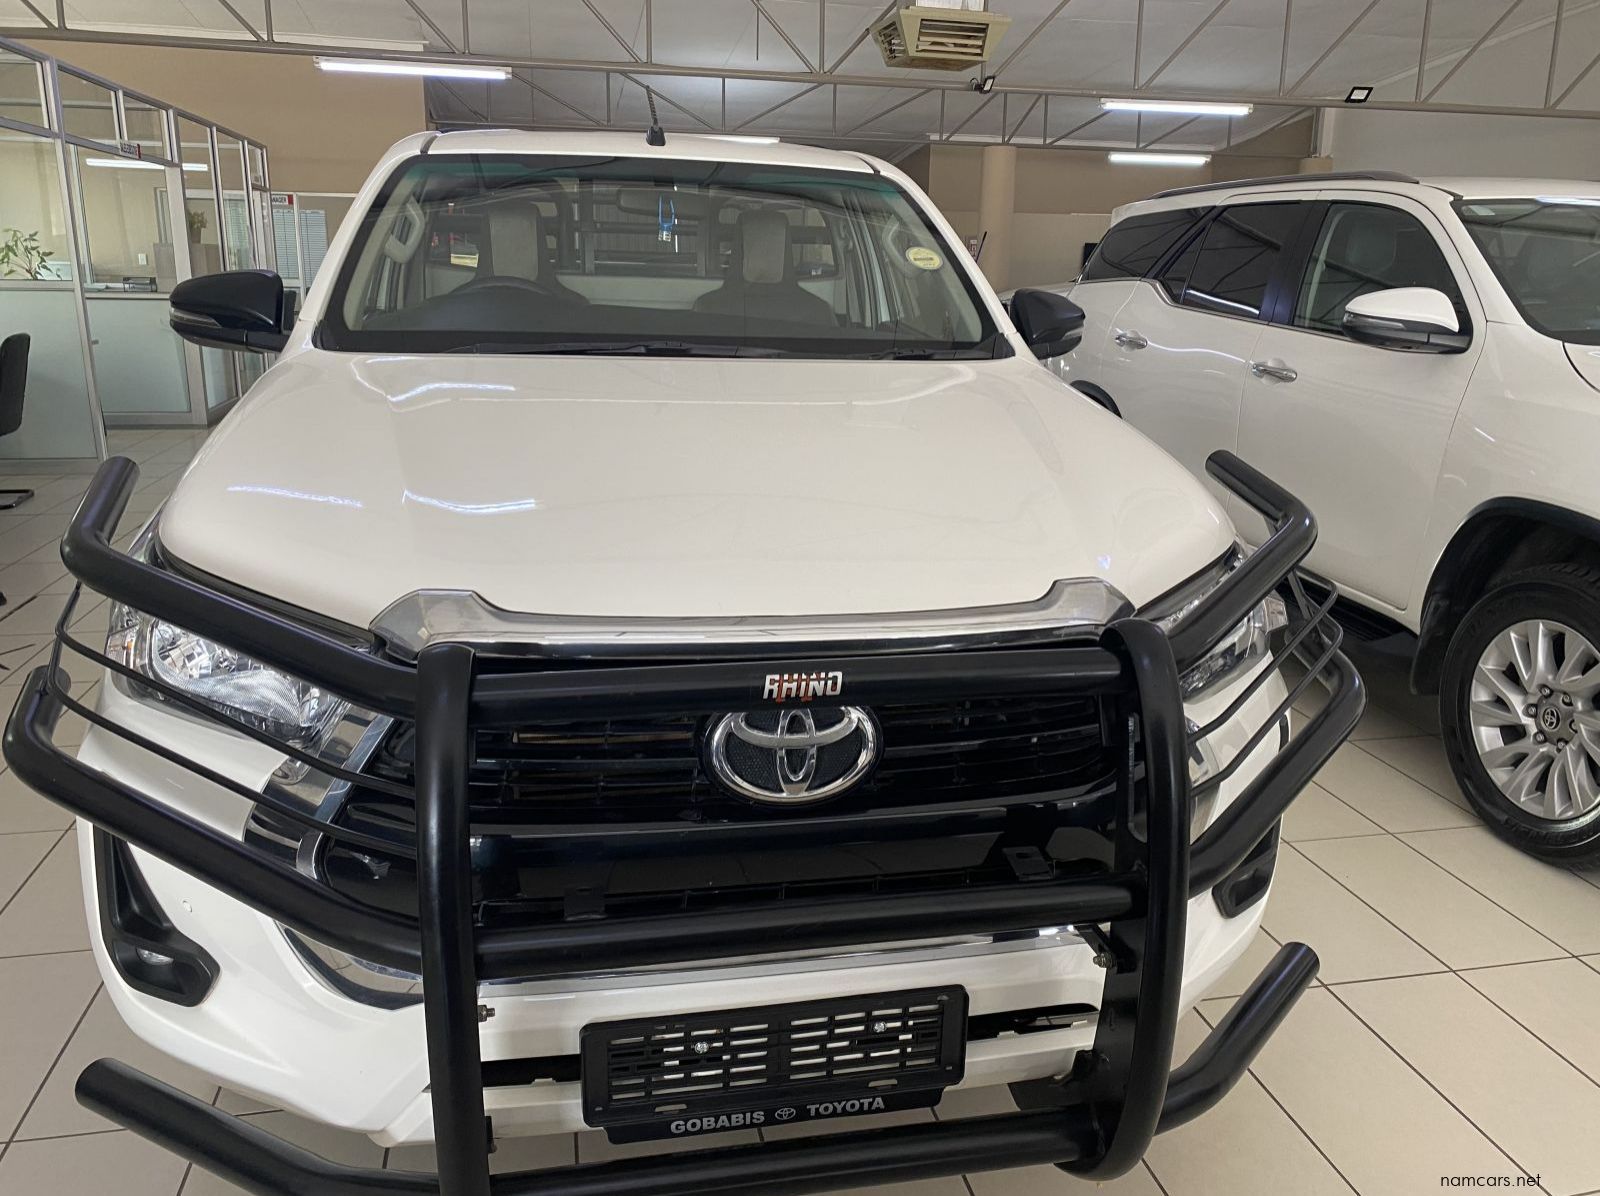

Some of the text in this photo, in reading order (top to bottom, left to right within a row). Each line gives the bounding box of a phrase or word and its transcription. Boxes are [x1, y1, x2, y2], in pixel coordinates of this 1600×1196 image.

[762, 671, 843, 702] RHINO
[670, 1097, 885, 1134] GOBABIS TOYOTA
